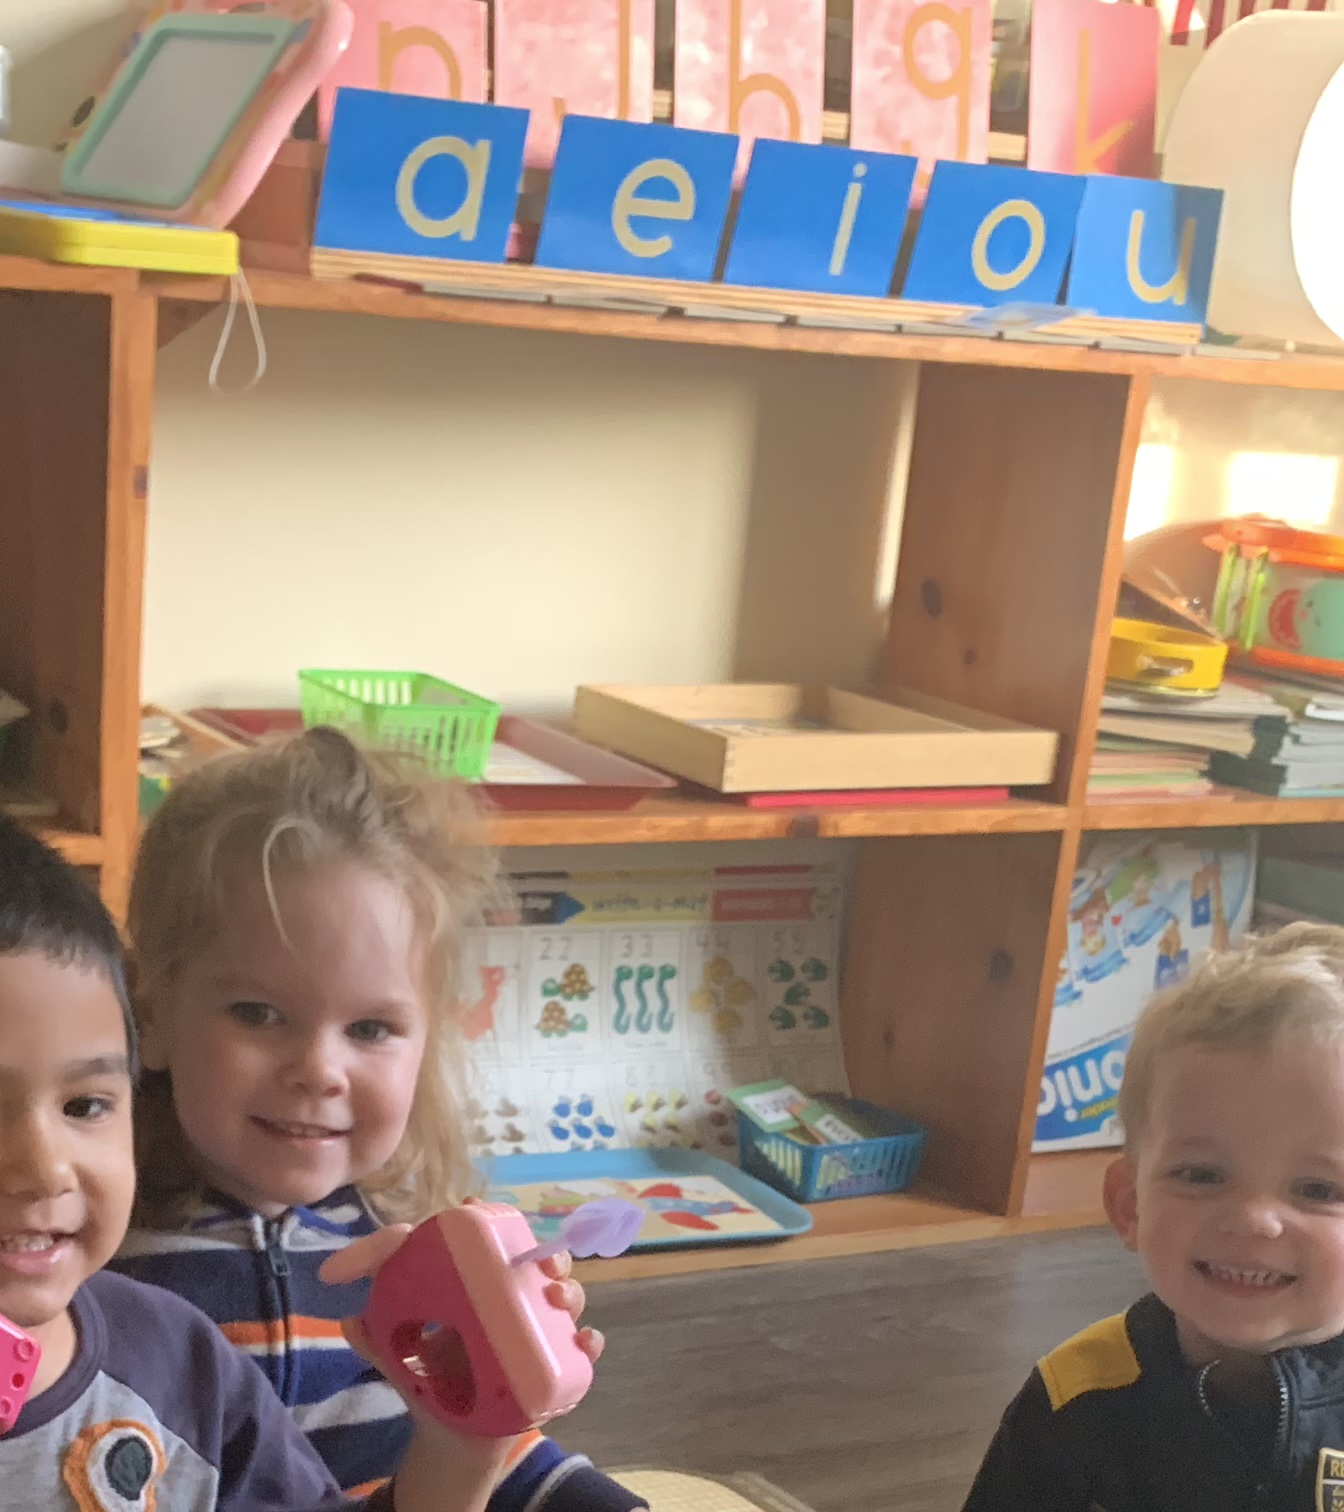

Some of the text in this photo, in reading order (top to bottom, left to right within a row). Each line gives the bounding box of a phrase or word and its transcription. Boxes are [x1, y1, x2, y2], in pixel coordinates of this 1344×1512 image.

[396, 135, 1197, 306] a e i o u
